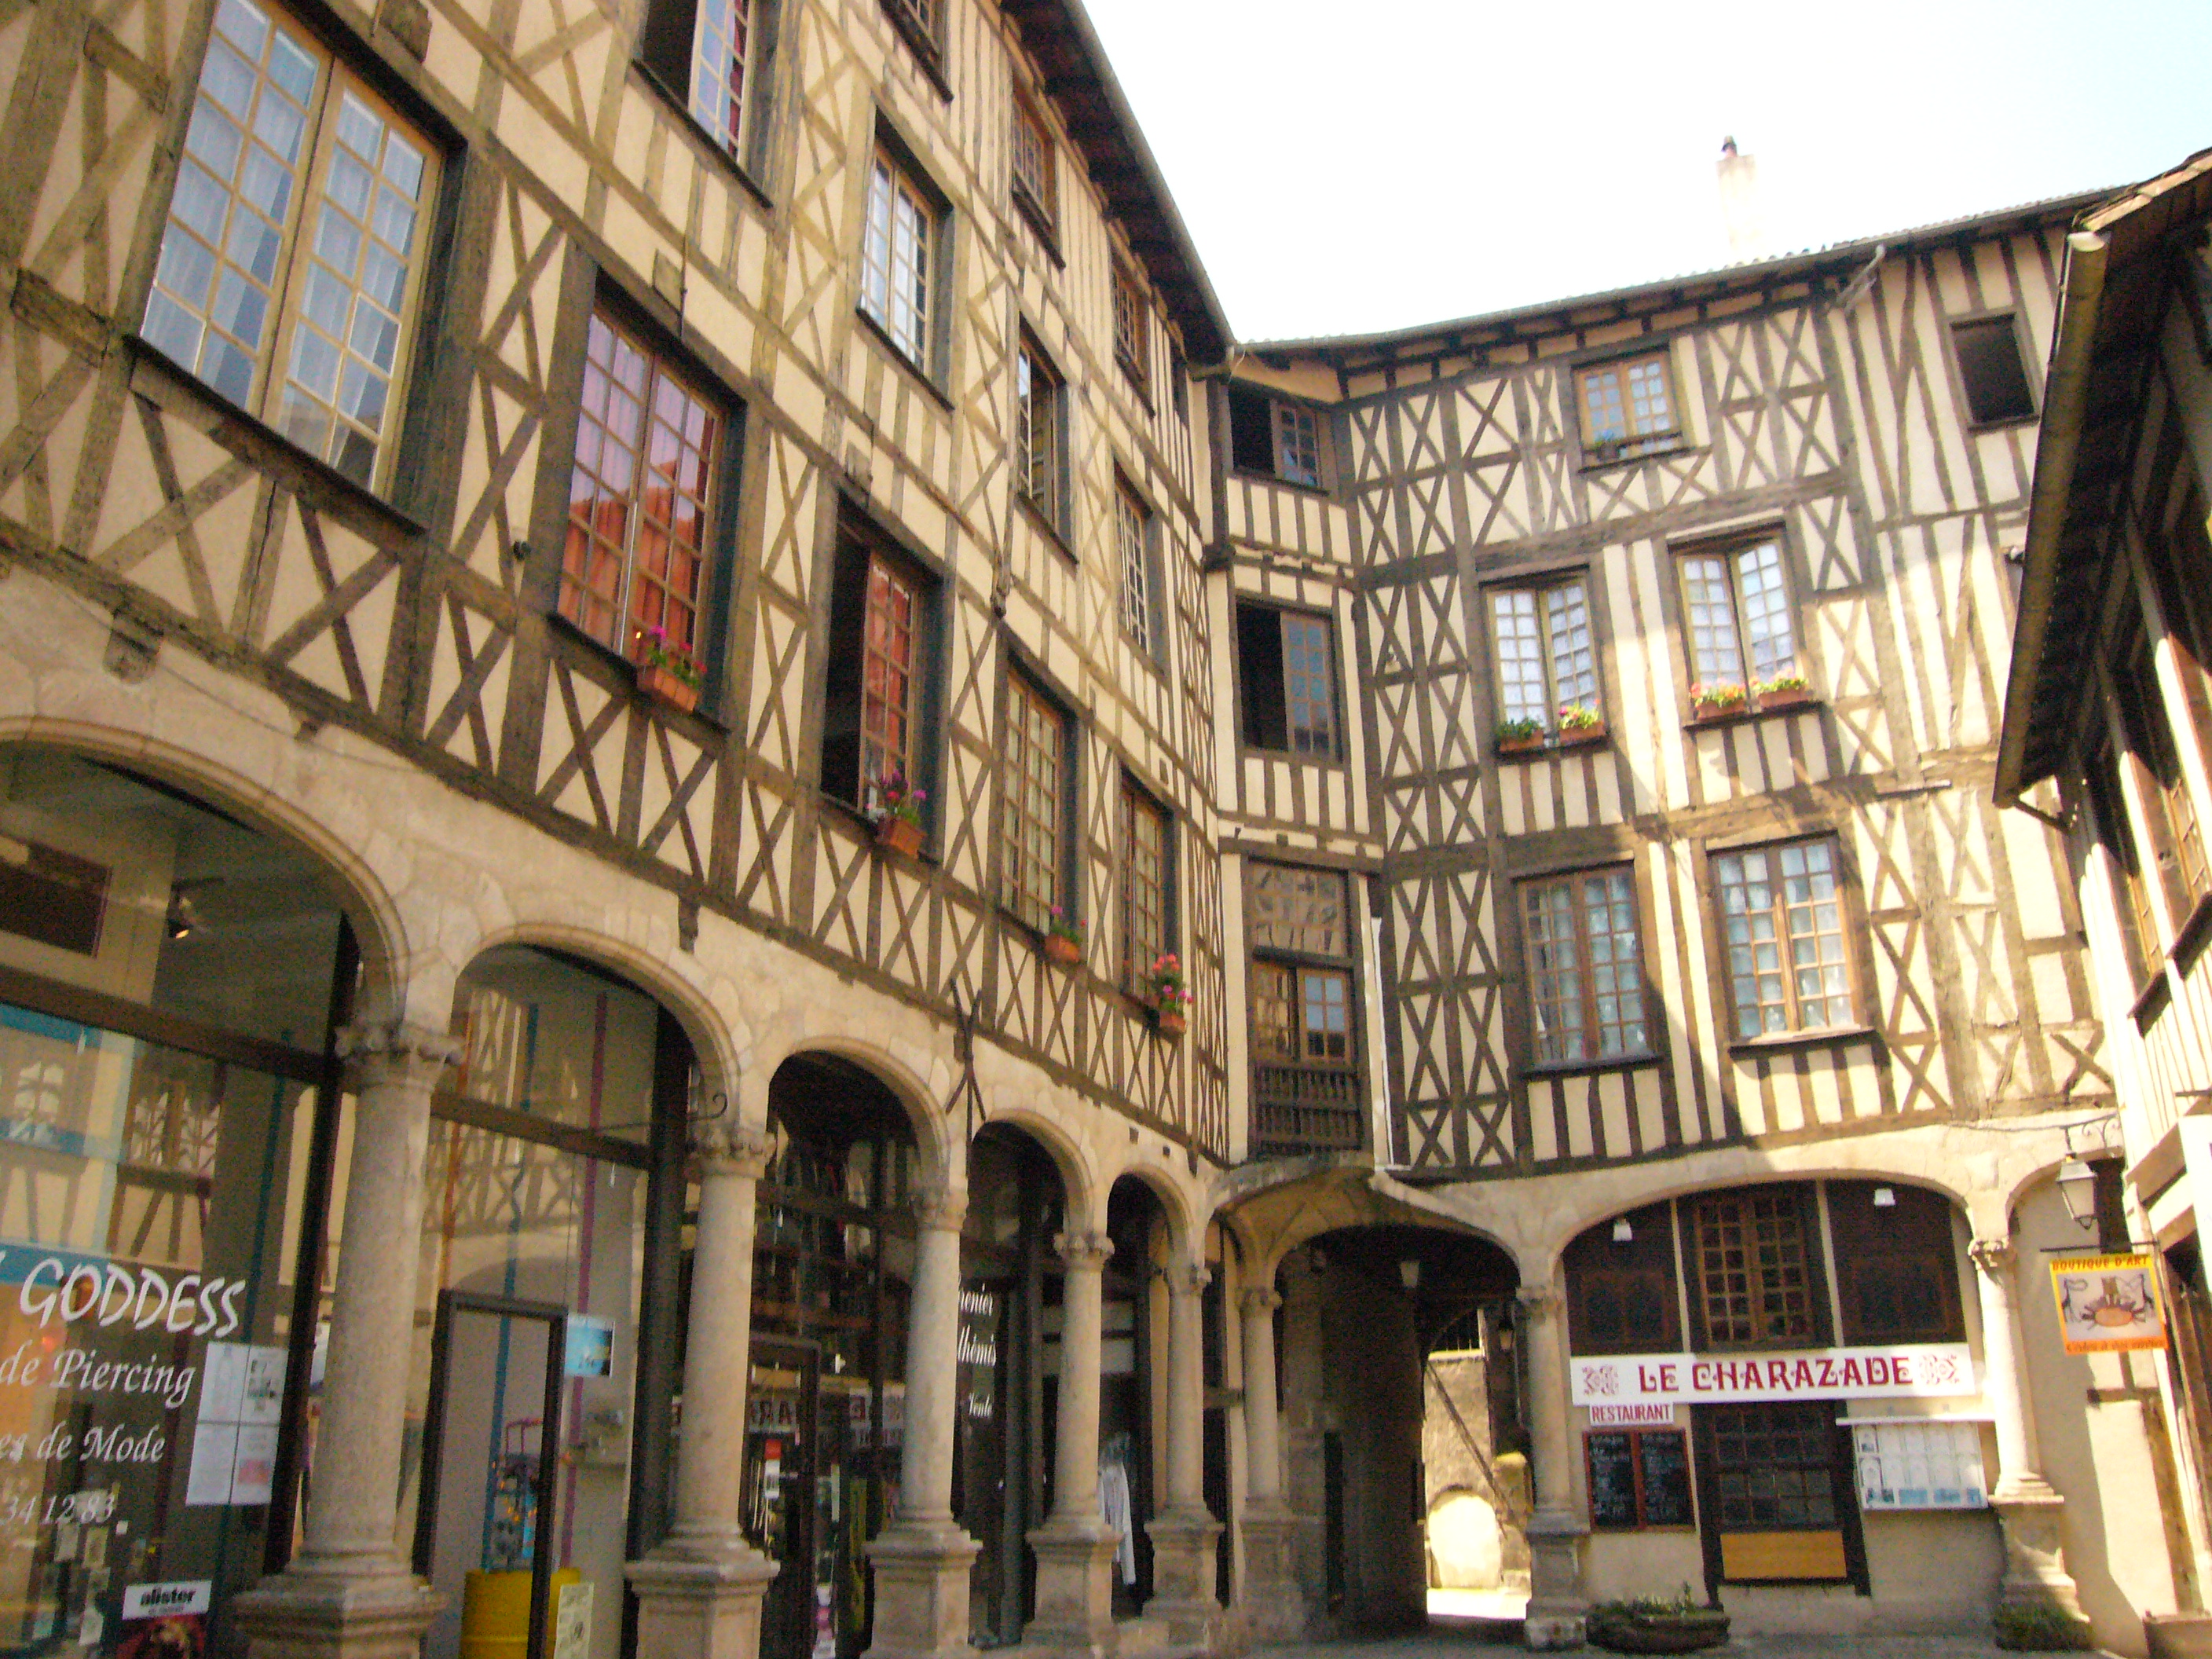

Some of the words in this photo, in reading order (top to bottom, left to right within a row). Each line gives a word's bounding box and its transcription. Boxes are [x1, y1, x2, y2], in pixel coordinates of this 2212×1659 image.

[2052, 1257, 2110, 1271] BOUTIQUE
[20, 1258, 246, 1338] GODDESS
[0, 1339, 42, 1387] de
[49, 1348, 196, 1409] Piercing
[1638, 1363, 1679, 1393] LE
[1692, 1356, 1914, 1393] CHARAZADE
[1591, 1403, 1671, 1423] RESTAURANT
[36, 1421, 73, 1461] de
[79, 1423, 166, 1463] Mode
[41, 1495, 76, 1524] 12
